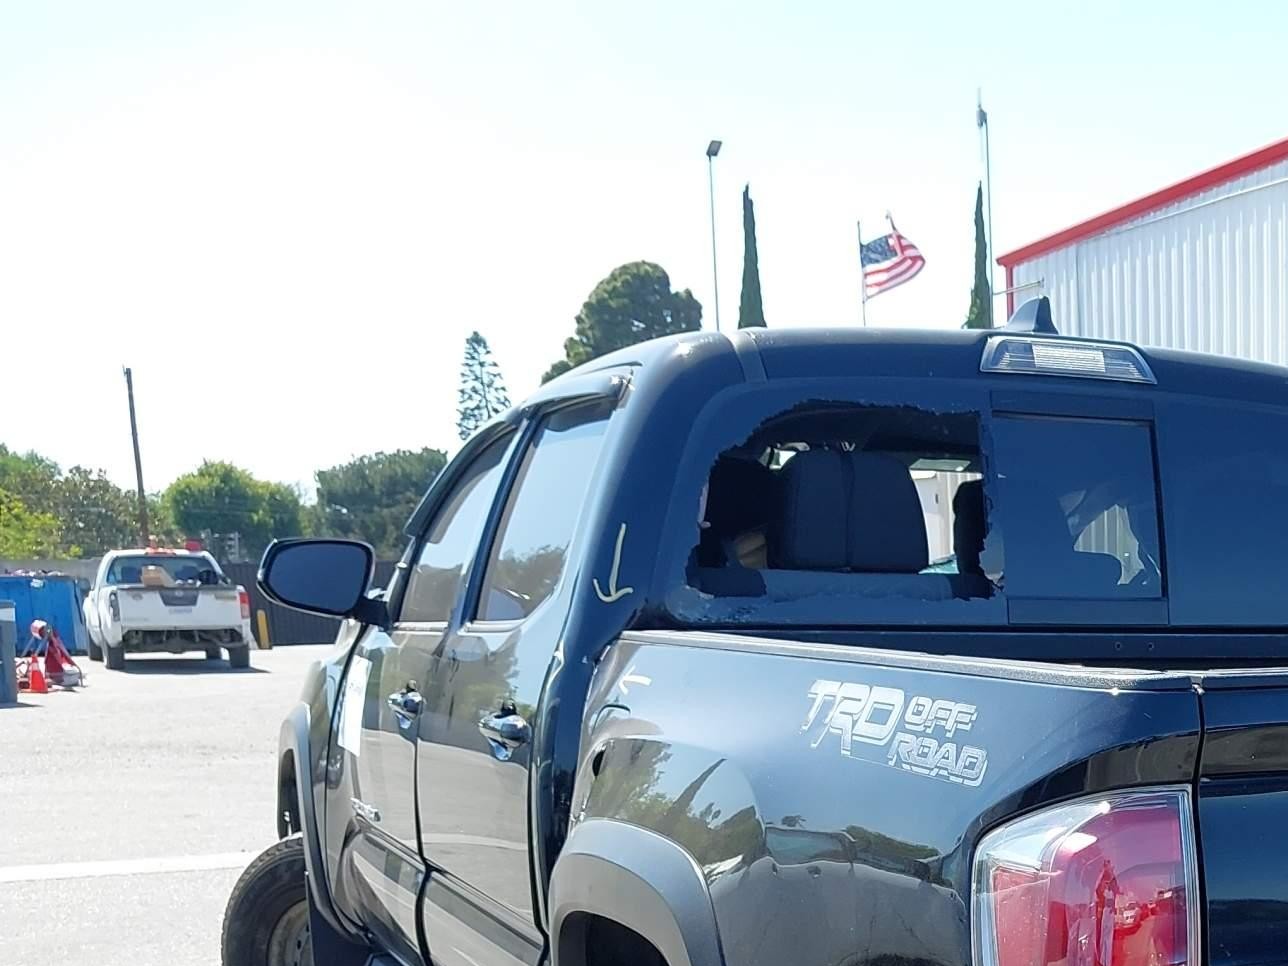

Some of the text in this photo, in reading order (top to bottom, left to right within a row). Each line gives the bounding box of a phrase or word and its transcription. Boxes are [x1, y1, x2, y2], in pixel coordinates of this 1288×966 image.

[801, 679, 978, 755] TRD OFF
[887, 731, 988, 787] ROAD
